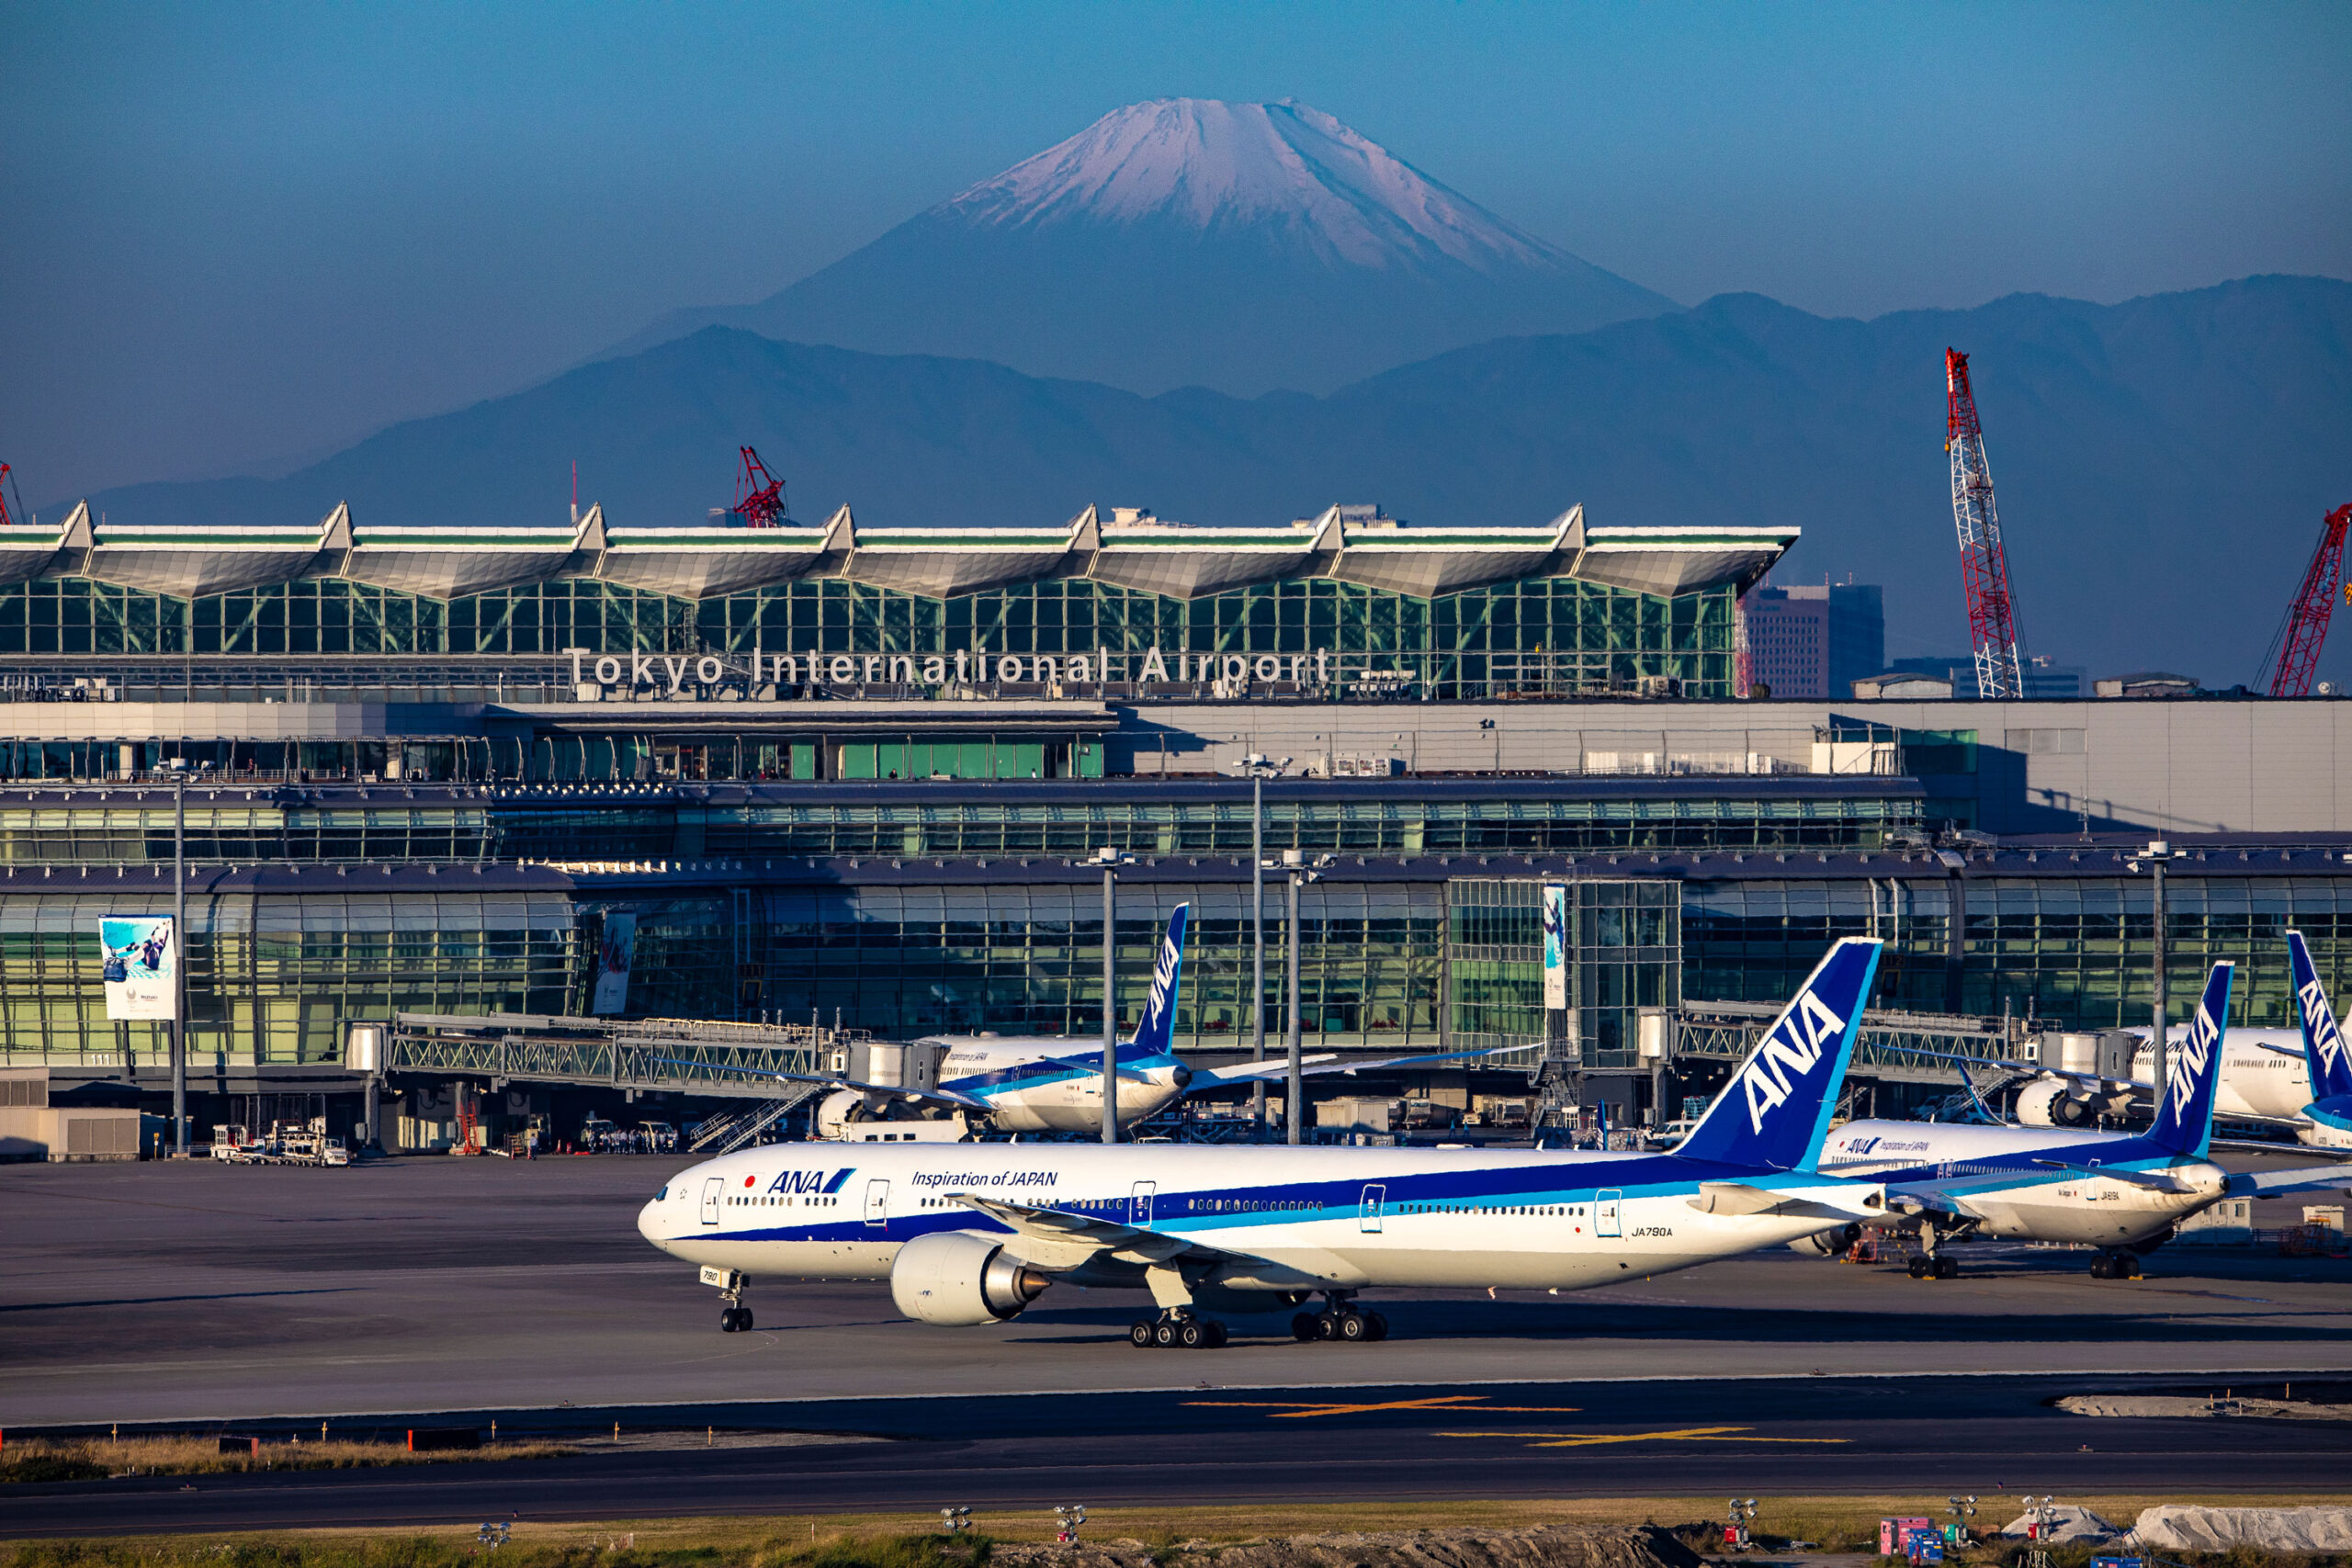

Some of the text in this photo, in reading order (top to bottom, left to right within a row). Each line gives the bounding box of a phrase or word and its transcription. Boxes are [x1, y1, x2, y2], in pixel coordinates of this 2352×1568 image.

[562, 646, 1330, 695] Tokyo International Airport
[1150, 935, 1180, 1032] ANA
[2299, 980, 2340, 1078] ANA
[91, 1054, 110, 1066] 111
[1744, 989, 1846, 1135] ANA
[2173, 1000, 2219, 1128] ANA
[1846, 1138, 1870, 1154] ANA
[767, 1170, 1058, 1194] ANA Inspiration of JAPAN
[1632, 1227, 1673, 1236] JA790A
[704, 1270, 718, 1280] 790
